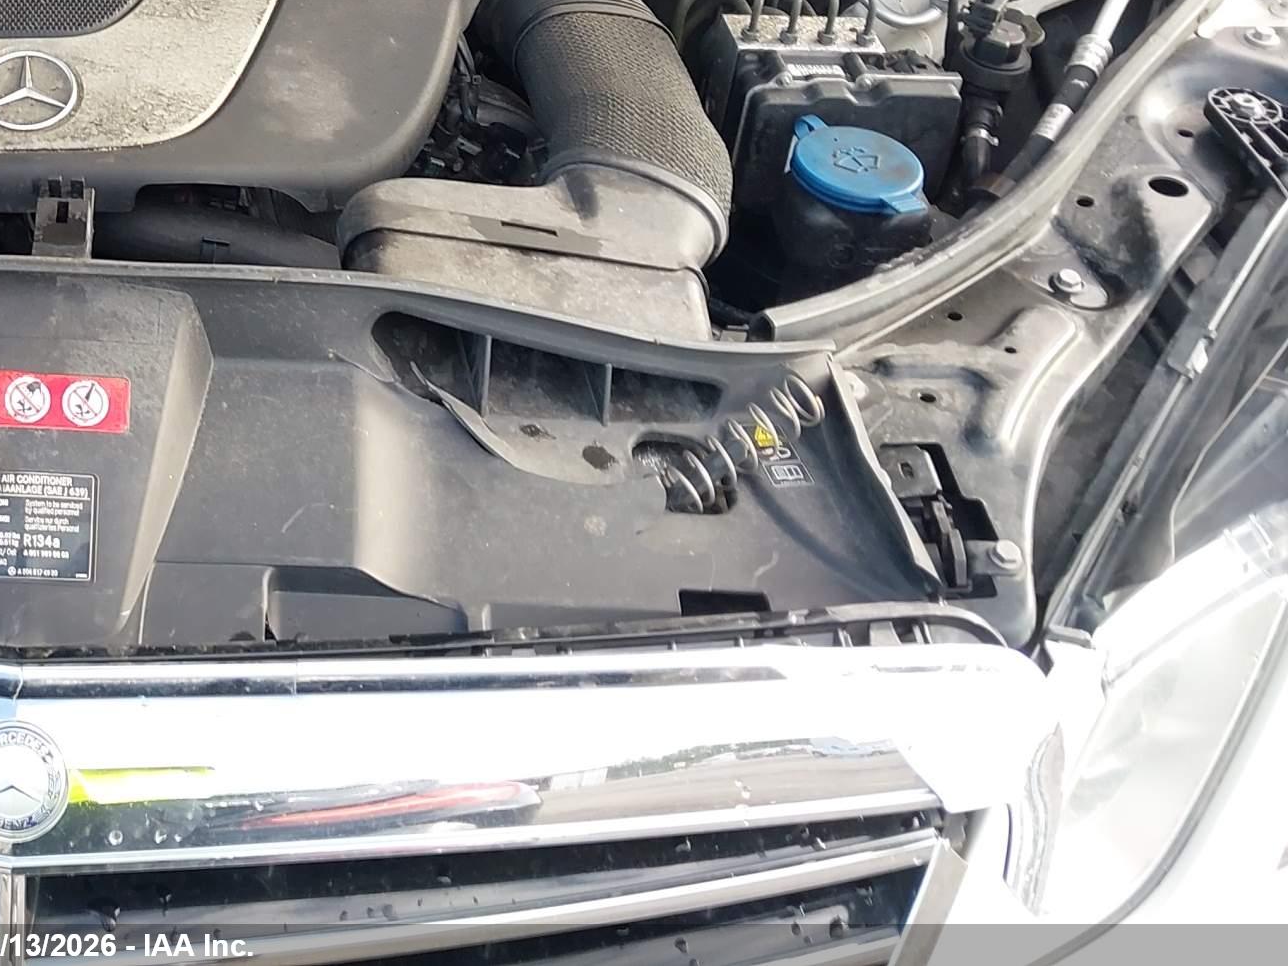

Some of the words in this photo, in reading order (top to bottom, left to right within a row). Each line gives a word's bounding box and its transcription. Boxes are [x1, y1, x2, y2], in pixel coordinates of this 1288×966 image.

[1, 474, 15, 484] AIR
[16, 474, 72, 487] CONDITIONER
[23, 533, 60, 548] R134a
